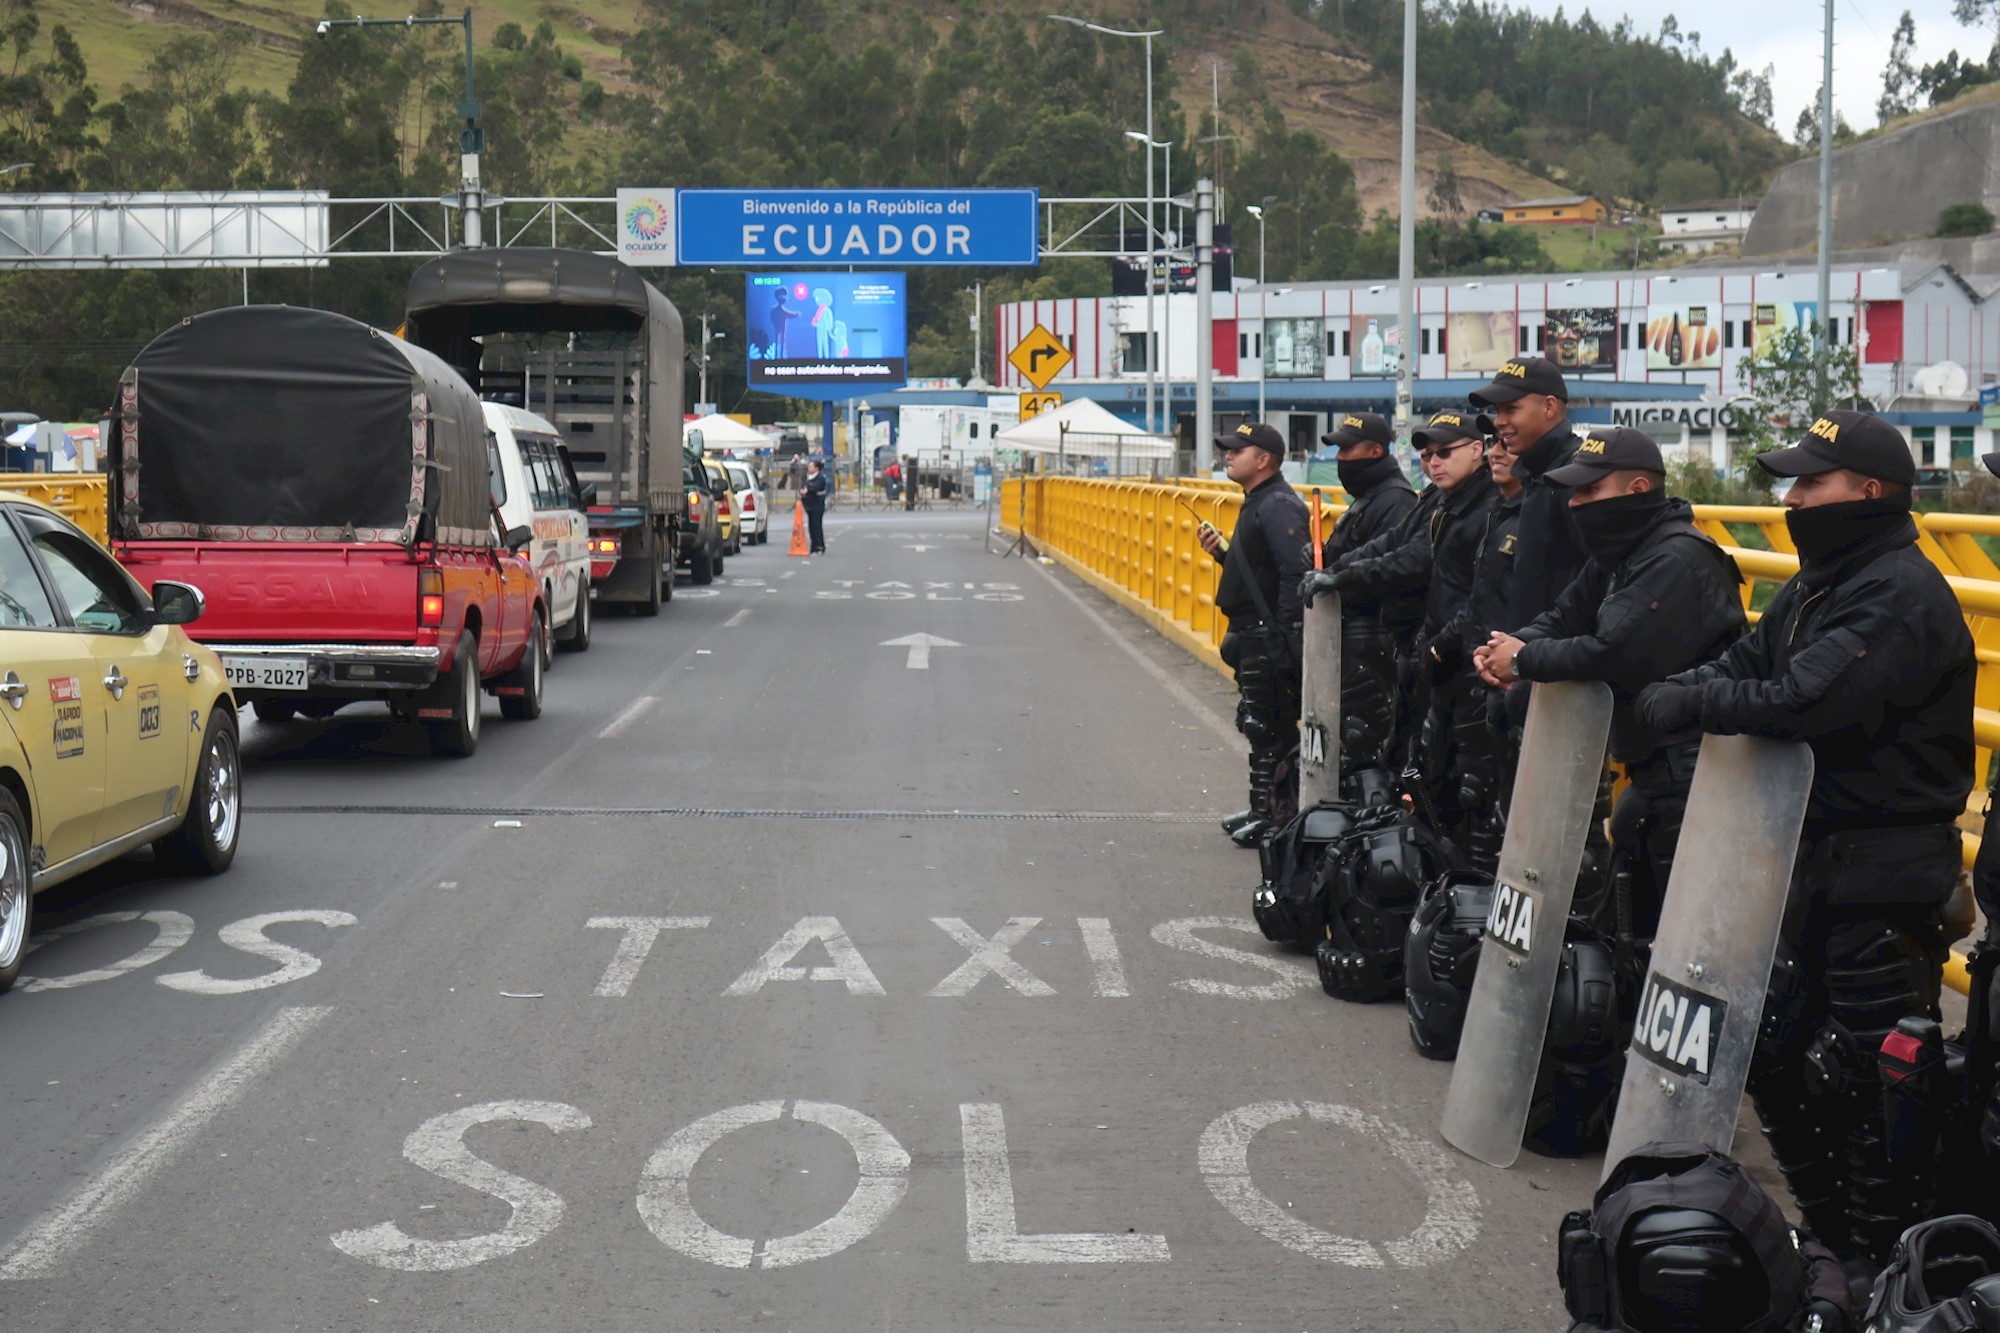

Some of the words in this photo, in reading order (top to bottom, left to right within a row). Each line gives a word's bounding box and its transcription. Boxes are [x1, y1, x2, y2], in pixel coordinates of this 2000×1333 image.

[743, 199, 829, 215] Bienvenido
[833, 203, 843, 215] a
[847, 199, 861, 215] la
[867, 199, 944, 217] República
[948, 199, 971, 215] del
[625, 241, 668, 252] ecuador
[742, 225, 971, 256] ECUADOR
[764, 367, 775, 376] no
[777, 366, 796, 376] sean
[797, 364, 843, 375] autoridades
[1613, 403, 1745, 428] MIGRACIÓ
[225, 667, 305, 686] PPB-2027
[141, 705, 159, 733] 003
[190, 709, 202, 733] R
[1486, 881, 1534, 952] ICIA
[585, 915, 1323, 1001] TAXIS
[329, 1099, 1483, 1272] SOLO
